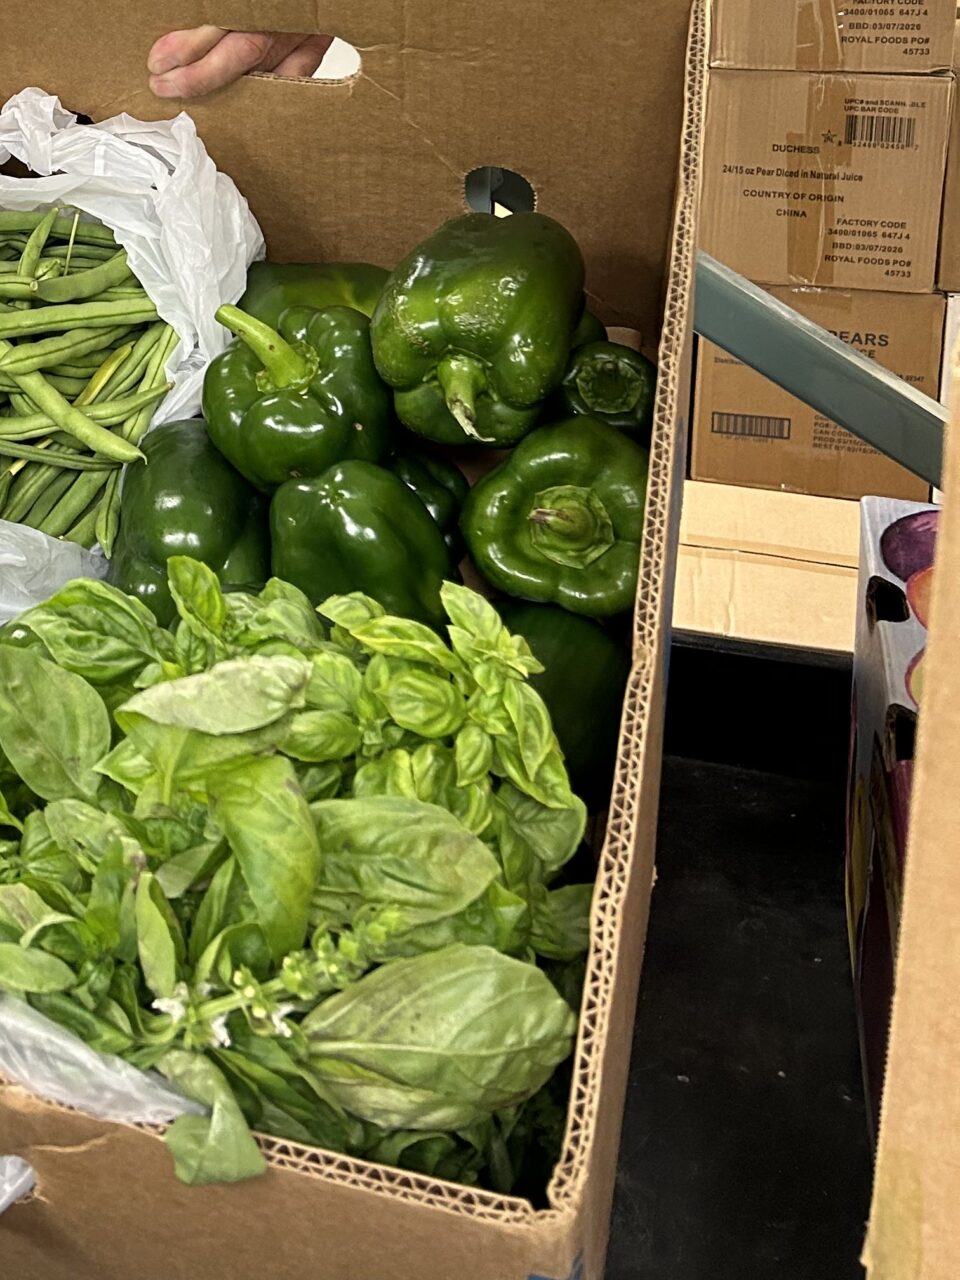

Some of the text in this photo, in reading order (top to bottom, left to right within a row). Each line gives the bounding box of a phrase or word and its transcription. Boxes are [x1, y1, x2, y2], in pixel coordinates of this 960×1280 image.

[841, 36, 873, 44] ROYAL
[879, 100, 926, 108] SCANNBLE
[772, 144, 820, 154] DUCHESS
[722, 165, 743, 175] 24/15
[745, 168, 754, 176] oz
[756, 167, 774, 177] Pear
[776, 168, 799, 178] Diced
[810, 170, 839, 181] Natural
[841, 172, 863, 181] Juice
[742, 189, 844, 202] COUNTRY OF ORIGIN
[776, 208, 807, 218] CHINA
[837, 218, 907, 229] FACTORY CODE
[825, 254, 911, 268] ROYAL FOODS PO#
[884, 270, 911, 278] 45733
